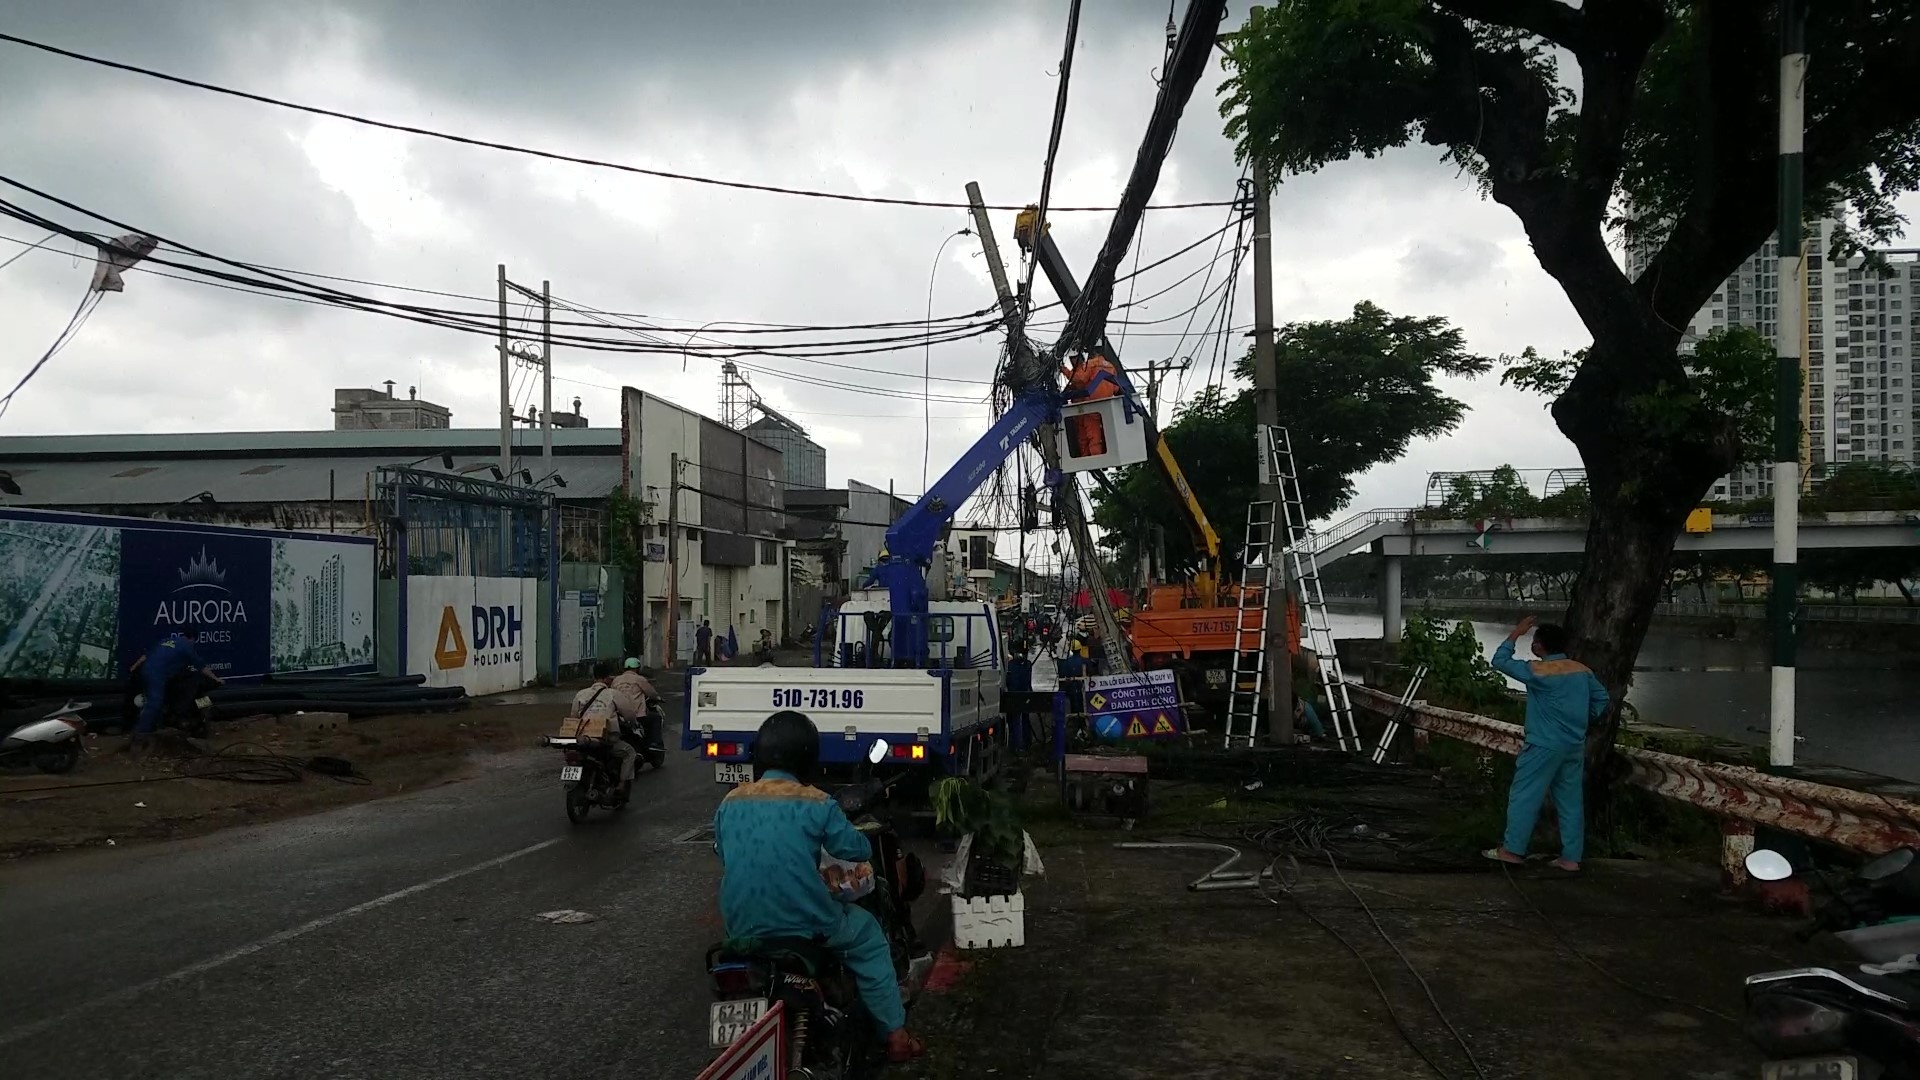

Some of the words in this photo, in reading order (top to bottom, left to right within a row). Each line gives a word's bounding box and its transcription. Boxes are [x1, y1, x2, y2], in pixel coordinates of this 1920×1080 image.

[153, 600, 248, 625] AURORA
[472, 605, 522, 650] DRH
[772, 688, 864, 709] 51D-731.96
[1111, 688, 1136, 700] CÔNG
[718, 773, 750, 783] 731.96
[725, 764, 743, 773] 51D
[719, 1002, 758, 1024] 62-H1
